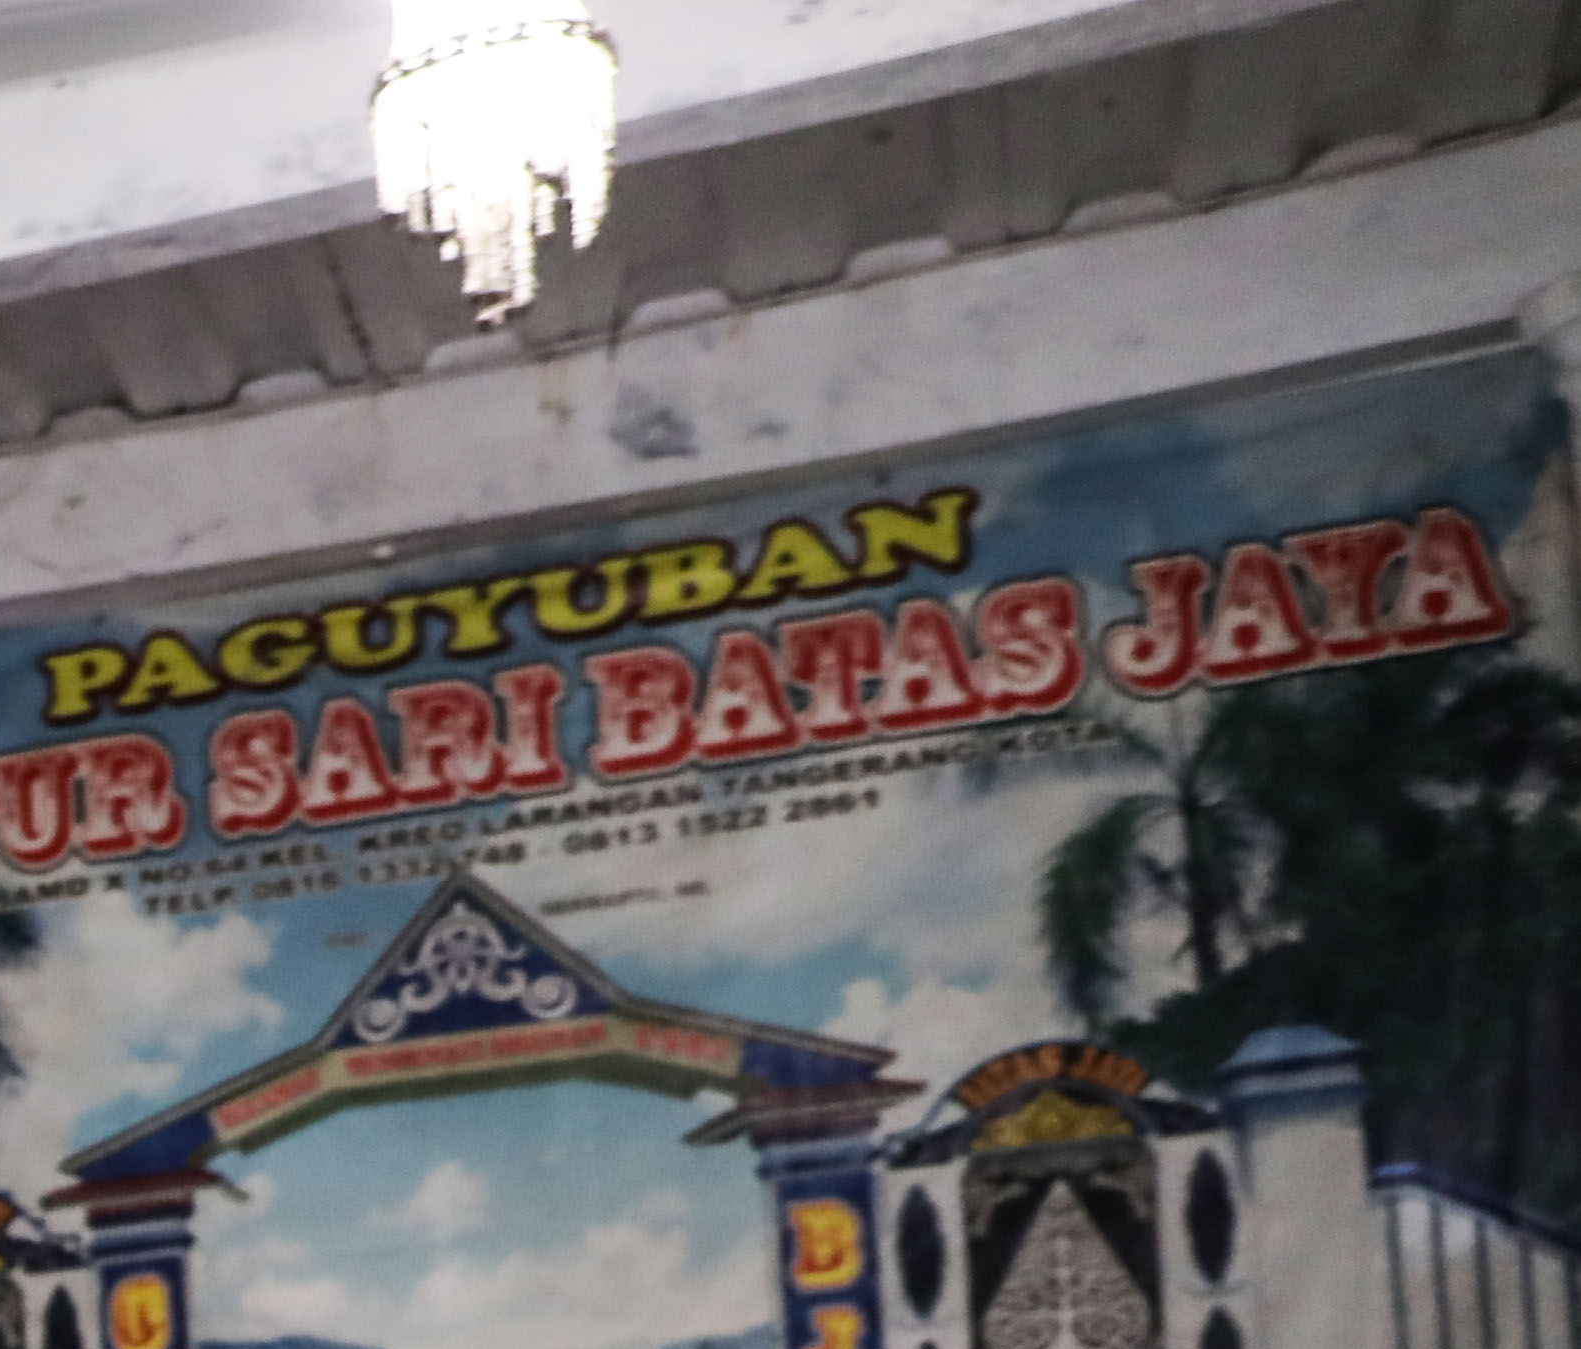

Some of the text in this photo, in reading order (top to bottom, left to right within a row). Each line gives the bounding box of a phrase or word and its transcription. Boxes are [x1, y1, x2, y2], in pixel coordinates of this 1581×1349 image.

[44, 488, 972, 722] PAGUYUBAN
[209, 664, 565, 837] SARI
[585, 578, 1085, 777] BATAS
[1104, 507, 1512, 696] JAYA
[360, 820, 459, 853] KREO
[480, 782, 702, 834] LARANGAN
[722, 739, 978, 798] TANGERANG
[997, 720, 1123, 756] KOTA
